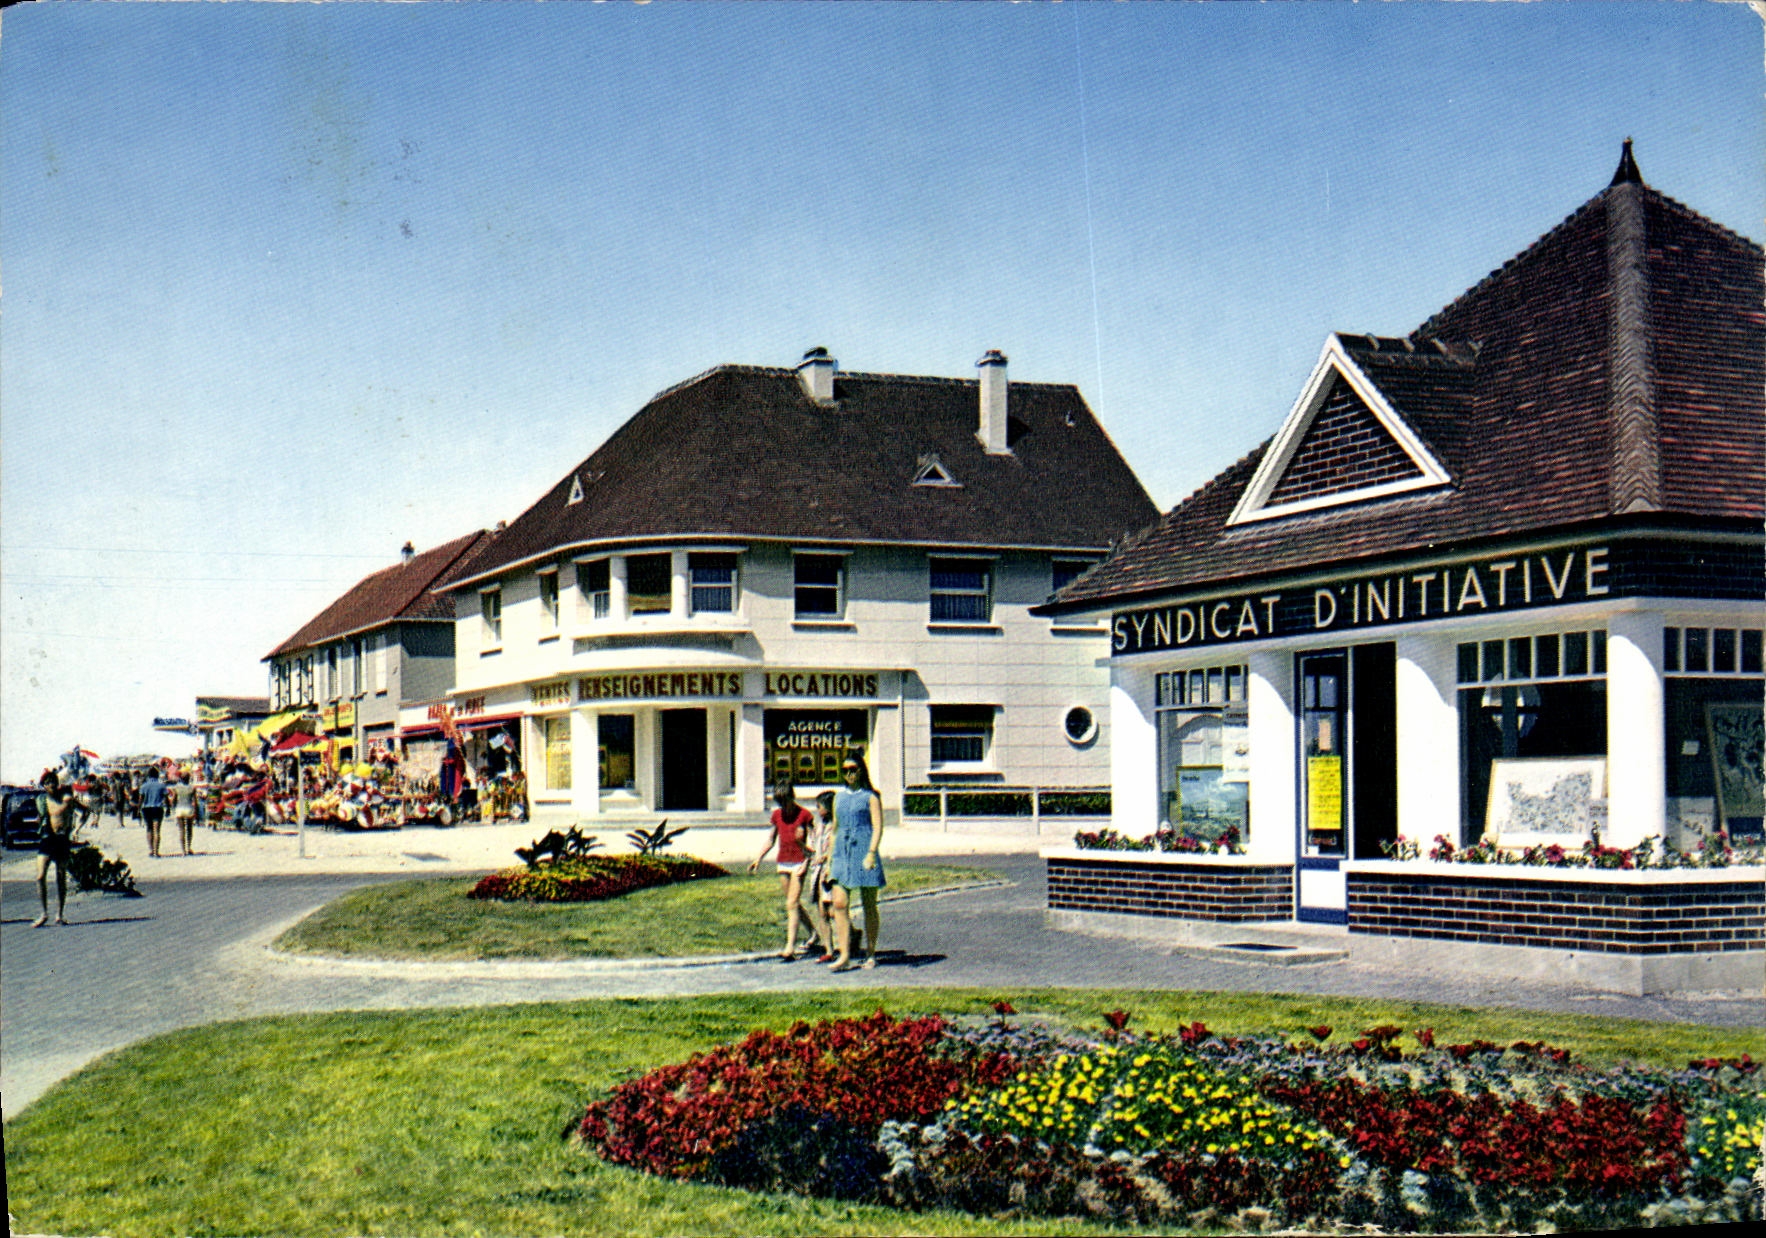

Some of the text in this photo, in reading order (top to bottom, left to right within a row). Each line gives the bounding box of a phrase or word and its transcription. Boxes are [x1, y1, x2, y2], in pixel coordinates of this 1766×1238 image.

[1113, 548, 1610, 650] SYNDICAT D'INITIATIVE
[579, 673, 740, 700] RENSEIGNEMENTS
[765, 673, 877, 696] LOCATIONS
[788, 721, 842, 732] AGENCE
[777, 734, 853, 749] GUERNET
